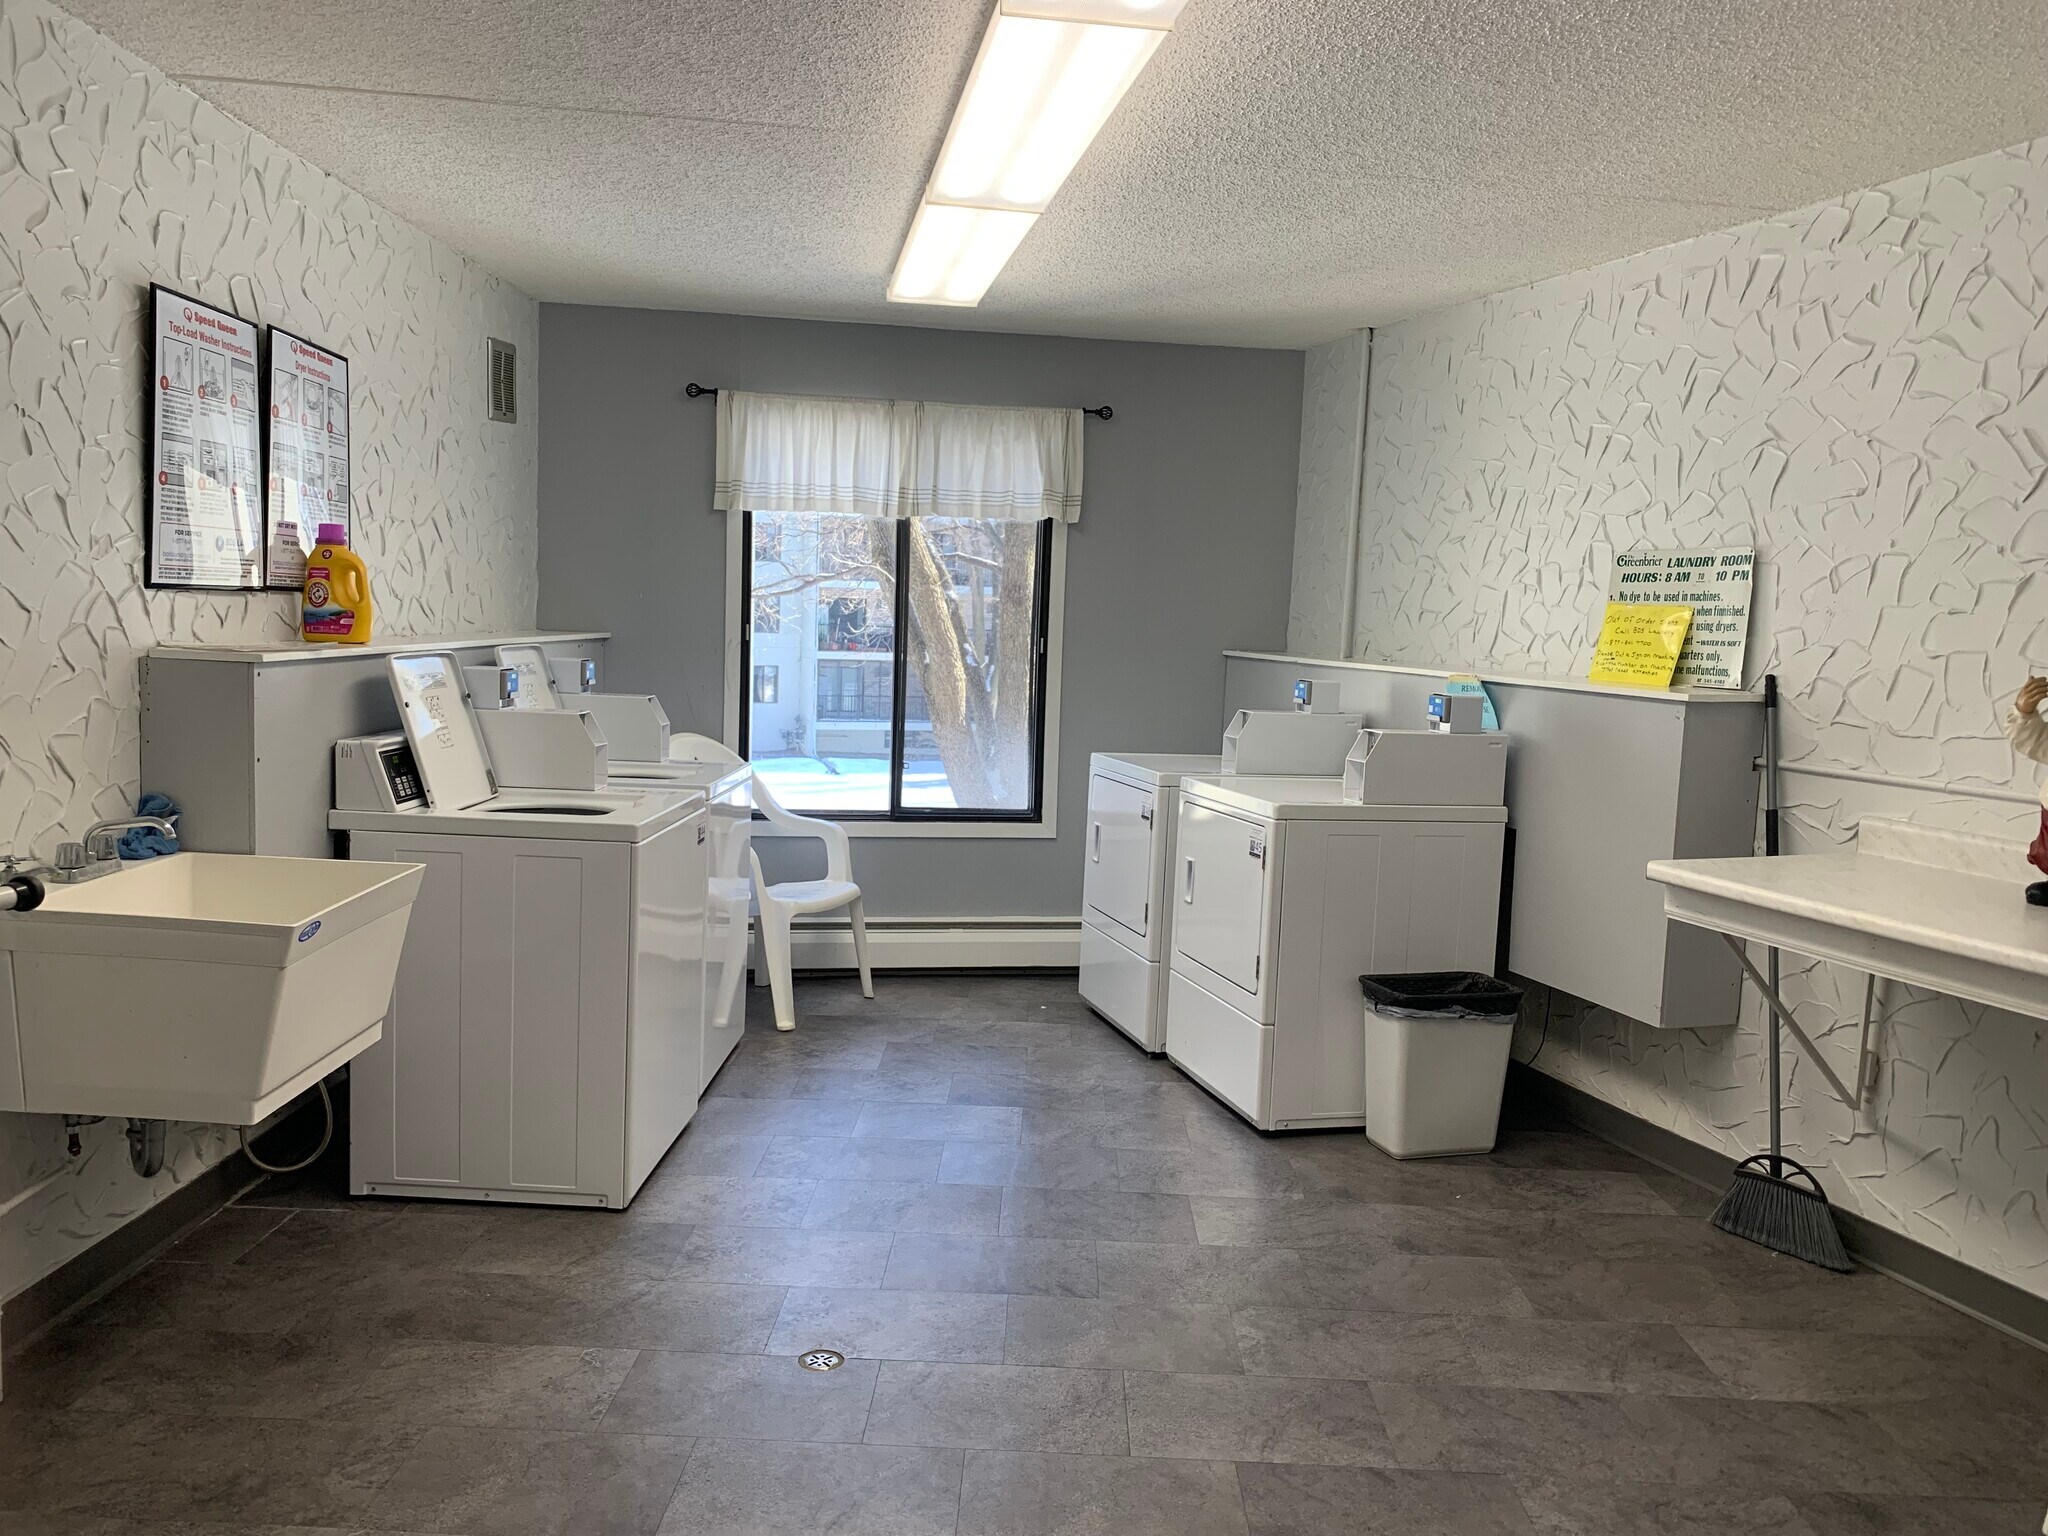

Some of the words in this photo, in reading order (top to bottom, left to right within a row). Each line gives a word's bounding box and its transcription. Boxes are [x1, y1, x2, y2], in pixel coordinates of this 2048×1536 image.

[194, 312, 216, 328] Speed
[217, 320, 238, 336] Queen
[168, 320, 198, 340] Top-Load
[198, 331, 220, 346] Washer
[222, 339, 252, 358] Instructions
[298, 344, 316, 359] Speed
[296, 360, 306, 374] Dryer
[1617, 553, 1662, 567] Greenbrier
[1667, 556, 1717, 568] LAUNDRY
[1720, 554, 1752, 566] ROOM
[1621, 572, 1662, 582] HOURS:
[1665, 572, 1672, 582] 8
[1674, 572, 1691, 582] AM
[1716, 570, 1728, 582] 10
[1732, 570, 1750, 581] PM
[1619, 591, 1628, 602] No
[1629, 591, 1640, 603] dye
[1644, 592, 1650, 602] to
[1653, 591, 1661, 602] be
[1664, 591, 1680, 602] used
[1682, 591, 1688, 602] in
[1690, 590, 1724, 602] machines.
[1696, 605, 1712, 616] when
[1606, 615, 1620, 624] Out
[1615, 626, 1630, 634] Call
[1696, 620, 1714, 634] using
[1716, 620, 1738, 634] dryers.
[1680, 650, 1704, 660] uarters
[1706, 650, 1722, 664] only.
[1686, 664, 1730, 678] malfunctions,
